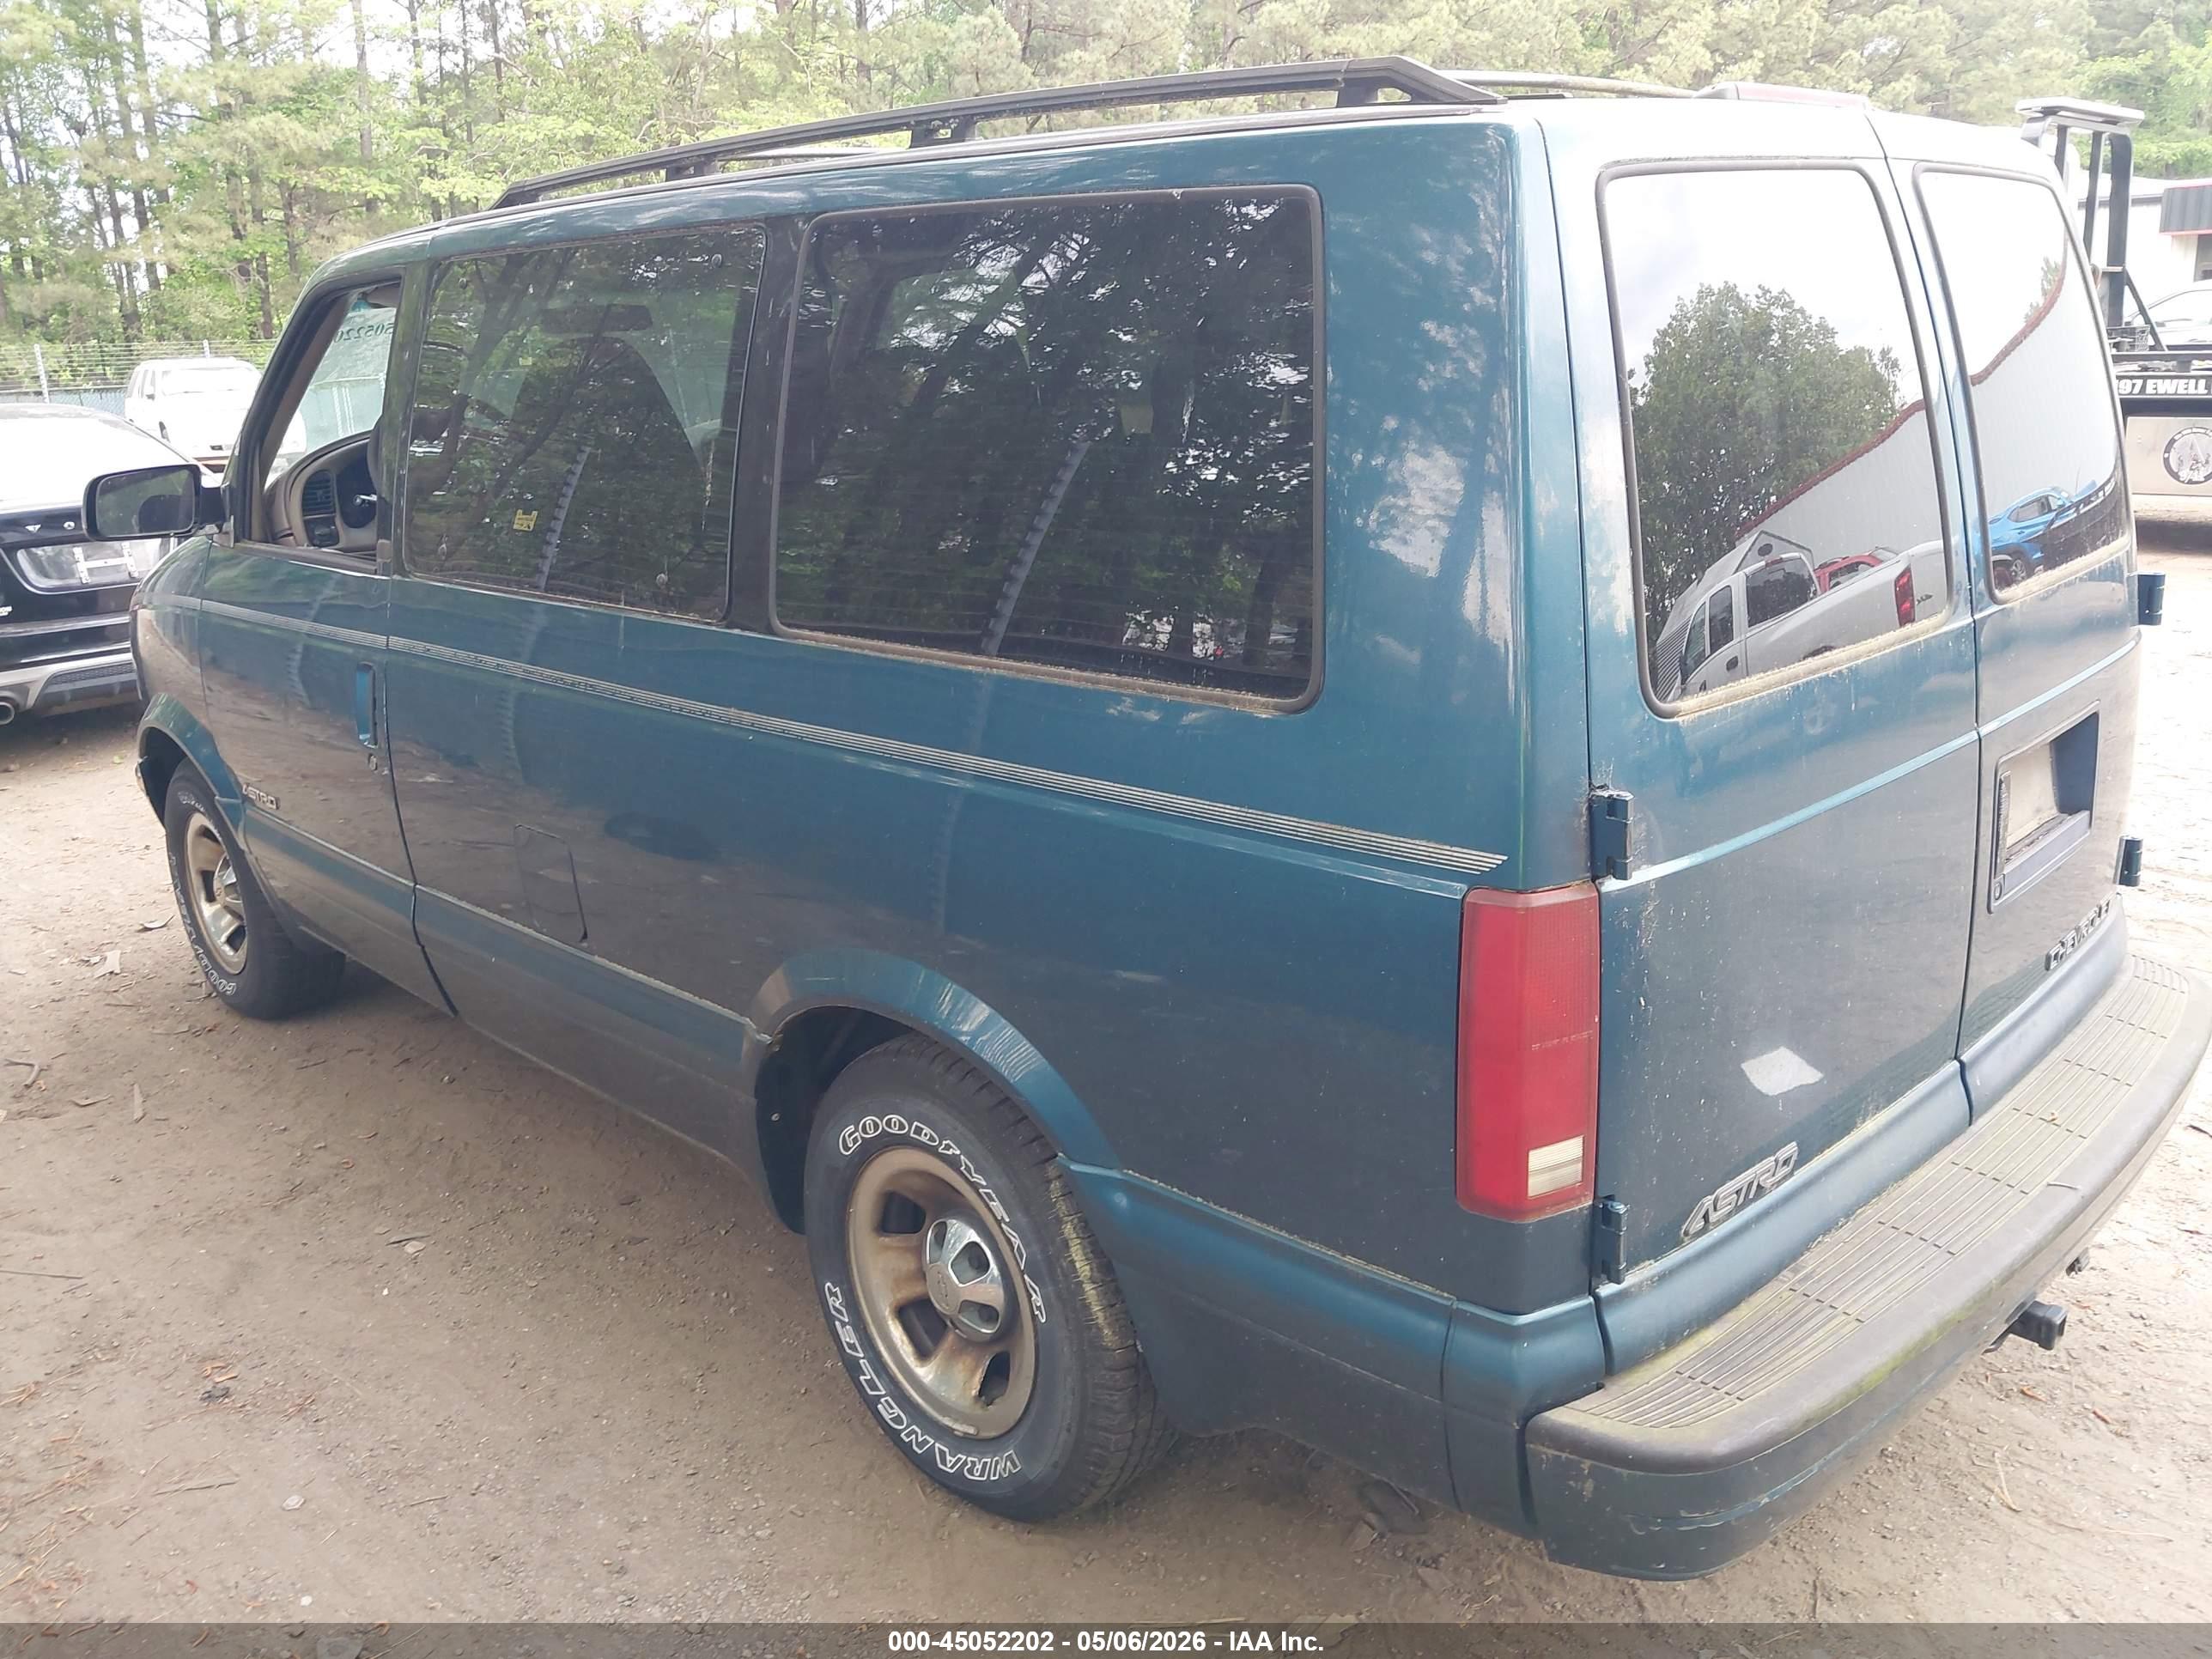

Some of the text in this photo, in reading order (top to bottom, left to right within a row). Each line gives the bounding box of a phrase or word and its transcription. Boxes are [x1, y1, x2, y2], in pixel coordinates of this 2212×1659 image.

[2117, 379, 2143, 394] 97
[2145, 379, 2208, 394] EWELL
[838, 1115, 1047, 1323] GOODYEAR
[1681, 1140, 1799, 1237] ASTRO
[824, 1281, 1023, 1481] WRANGLER
